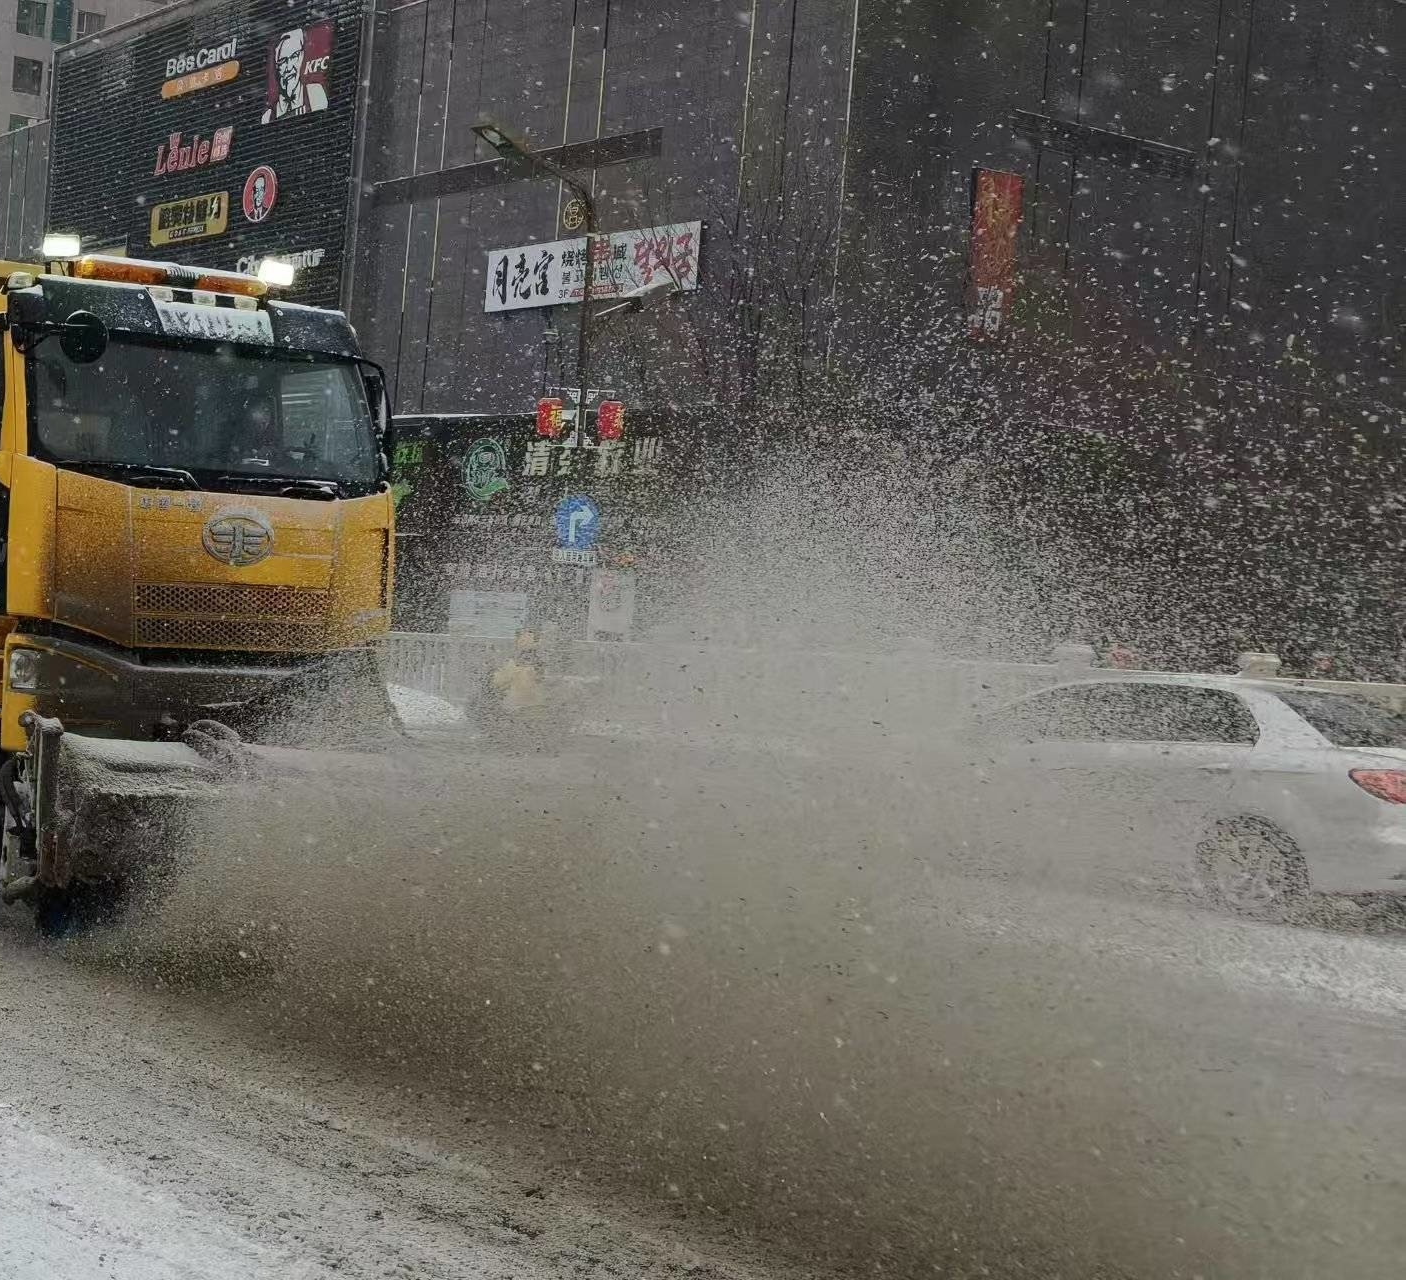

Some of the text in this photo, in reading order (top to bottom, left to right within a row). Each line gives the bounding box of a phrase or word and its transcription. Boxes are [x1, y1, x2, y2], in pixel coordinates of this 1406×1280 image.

[304, 55, 330, 75] KFC
[492, 248, 555, 305] 月亮宫
[558, 289, 569, 299] 3F
